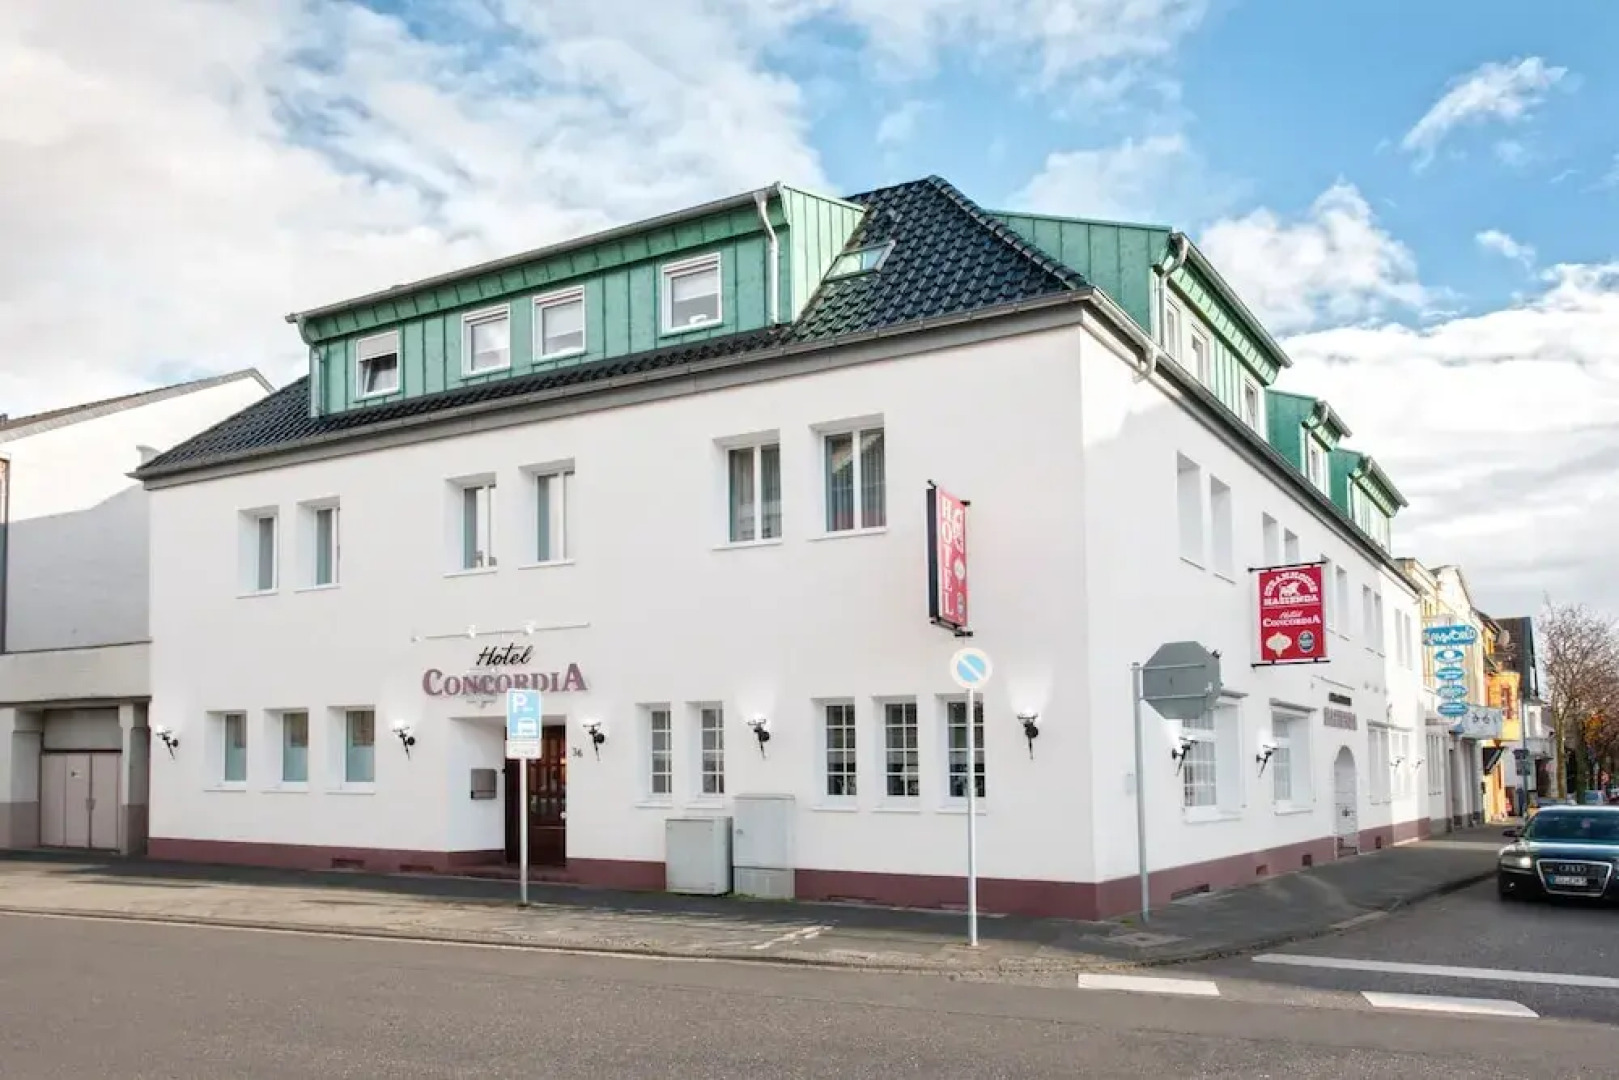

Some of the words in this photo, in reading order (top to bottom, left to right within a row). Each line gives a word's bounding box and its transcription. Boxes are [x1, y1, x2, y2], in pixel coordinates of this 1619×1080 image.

[941, 496, 954, 615] HOTEL
[476, 643, 534, 666] Hotel
[422, 663, 588, 696] CONCORDIA
[512, 692, 527, 713] P
